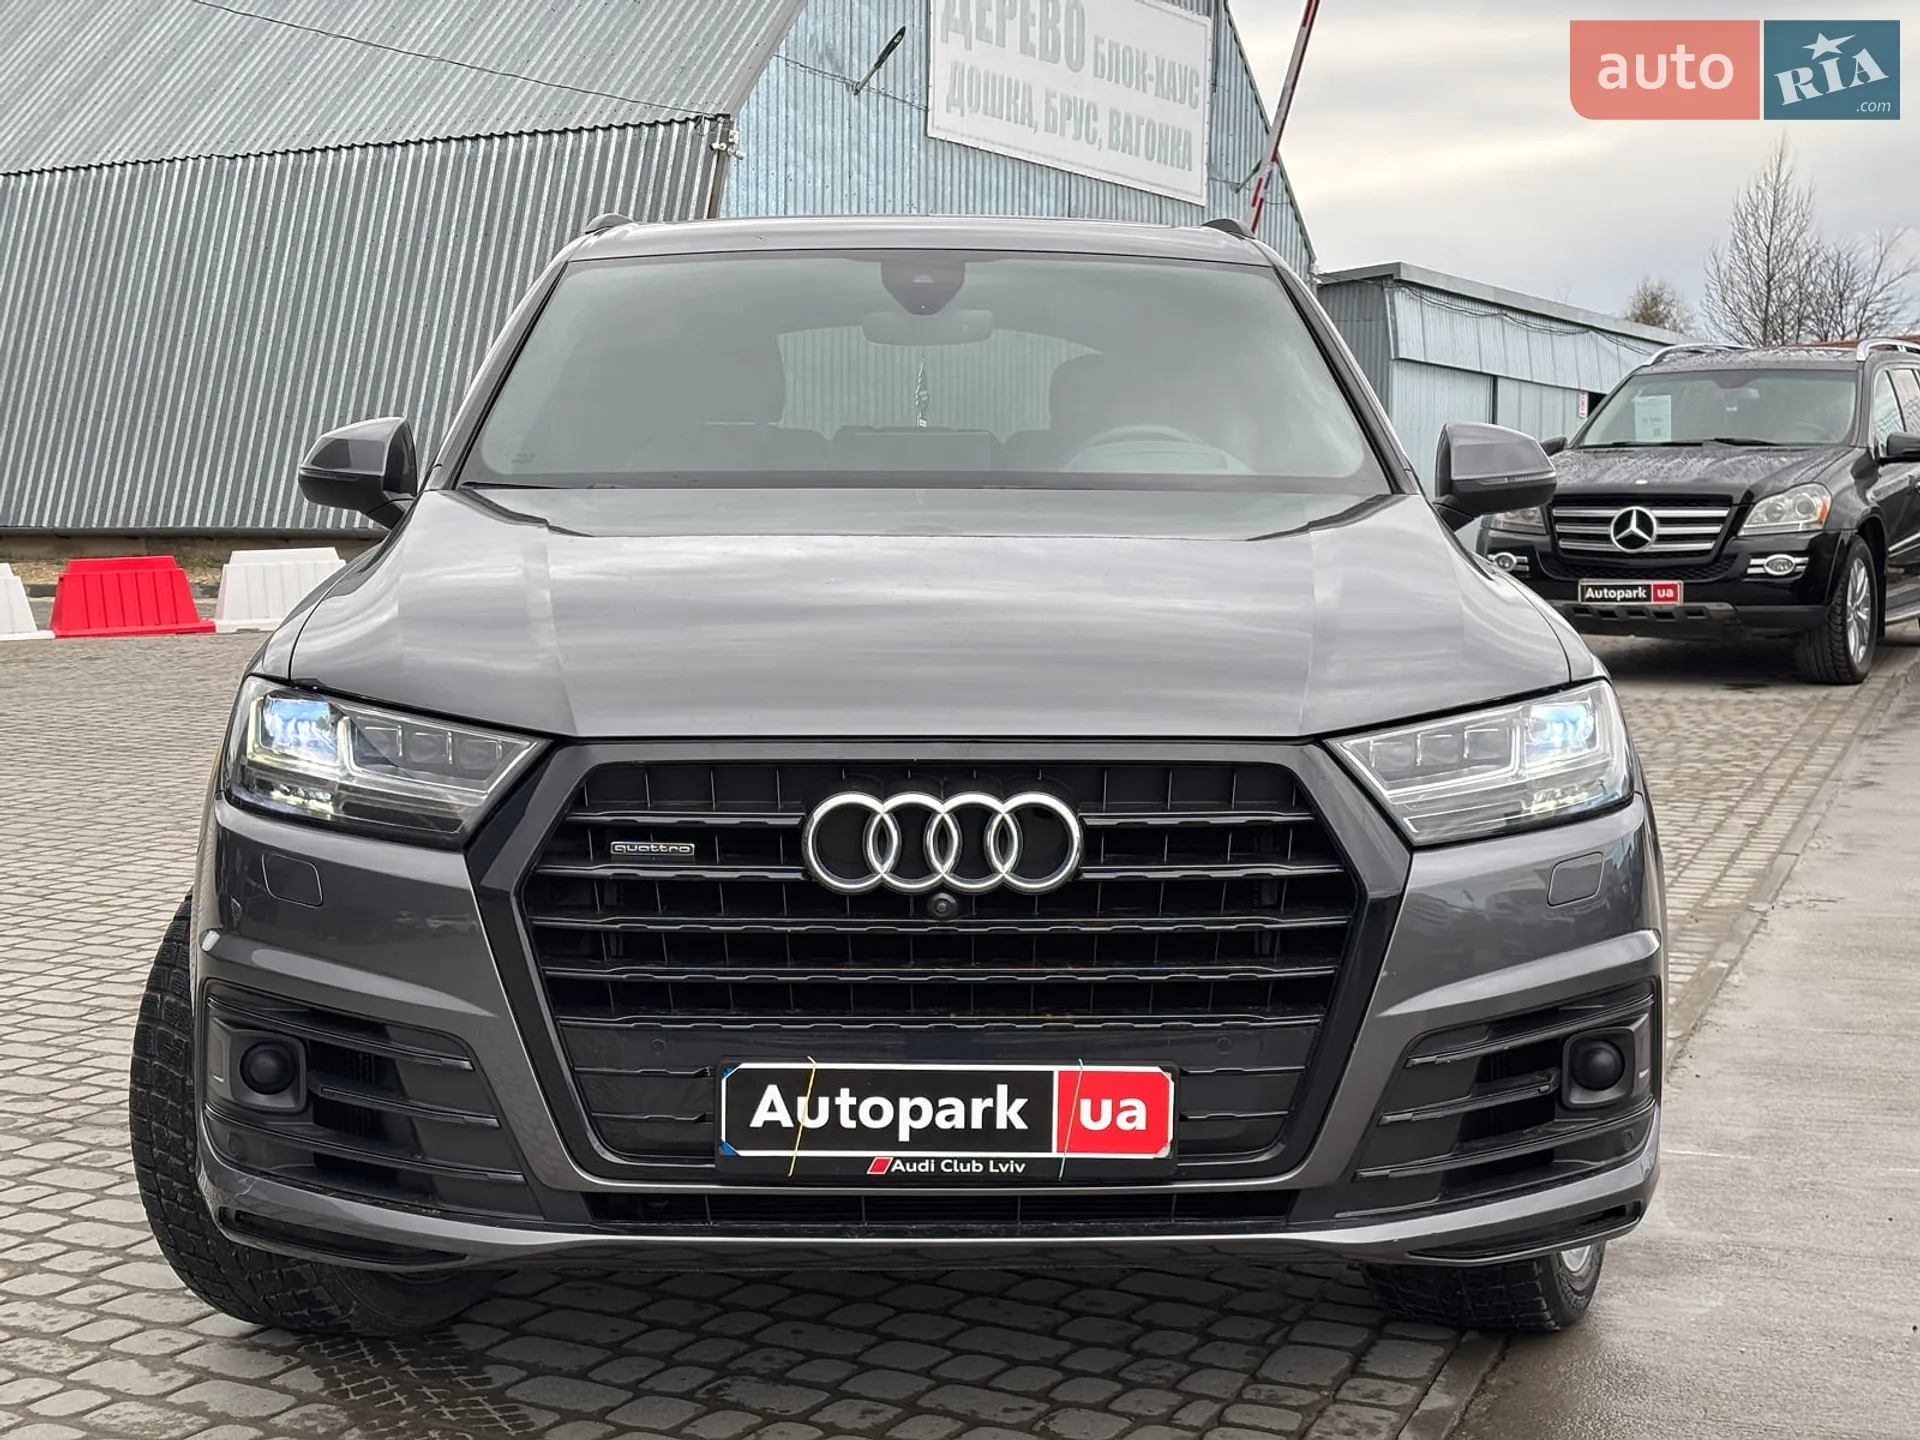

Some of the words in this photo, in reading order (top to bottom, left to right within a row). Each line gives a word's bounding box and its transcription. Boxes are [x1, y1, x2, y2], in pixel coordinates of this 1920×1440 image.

[940, 0, 1086, 73] ДЕРЕВО
[1093, 34, 1200, 110] БЛОК-ХАУС
[945, 60, 1038, 134] ДОШКА,
[1044, 88, 1102, 151] БРУС,
[1108, 107, 1193, 172] ВАГОНКА
[1585, 586, 1647, 601] Autopark
[1656, 588, 1674, 599] ua
[614, 844, 691, 854] quattro
[749, 1083, 1029, 1142] Autopark
[1078, 1096, 1148, 1132] ua
[891, 1159, 935, 1173] Audi
[940, 1159, 984, 1173] Club
[989, 1159, 1026, 1173] Lviv
